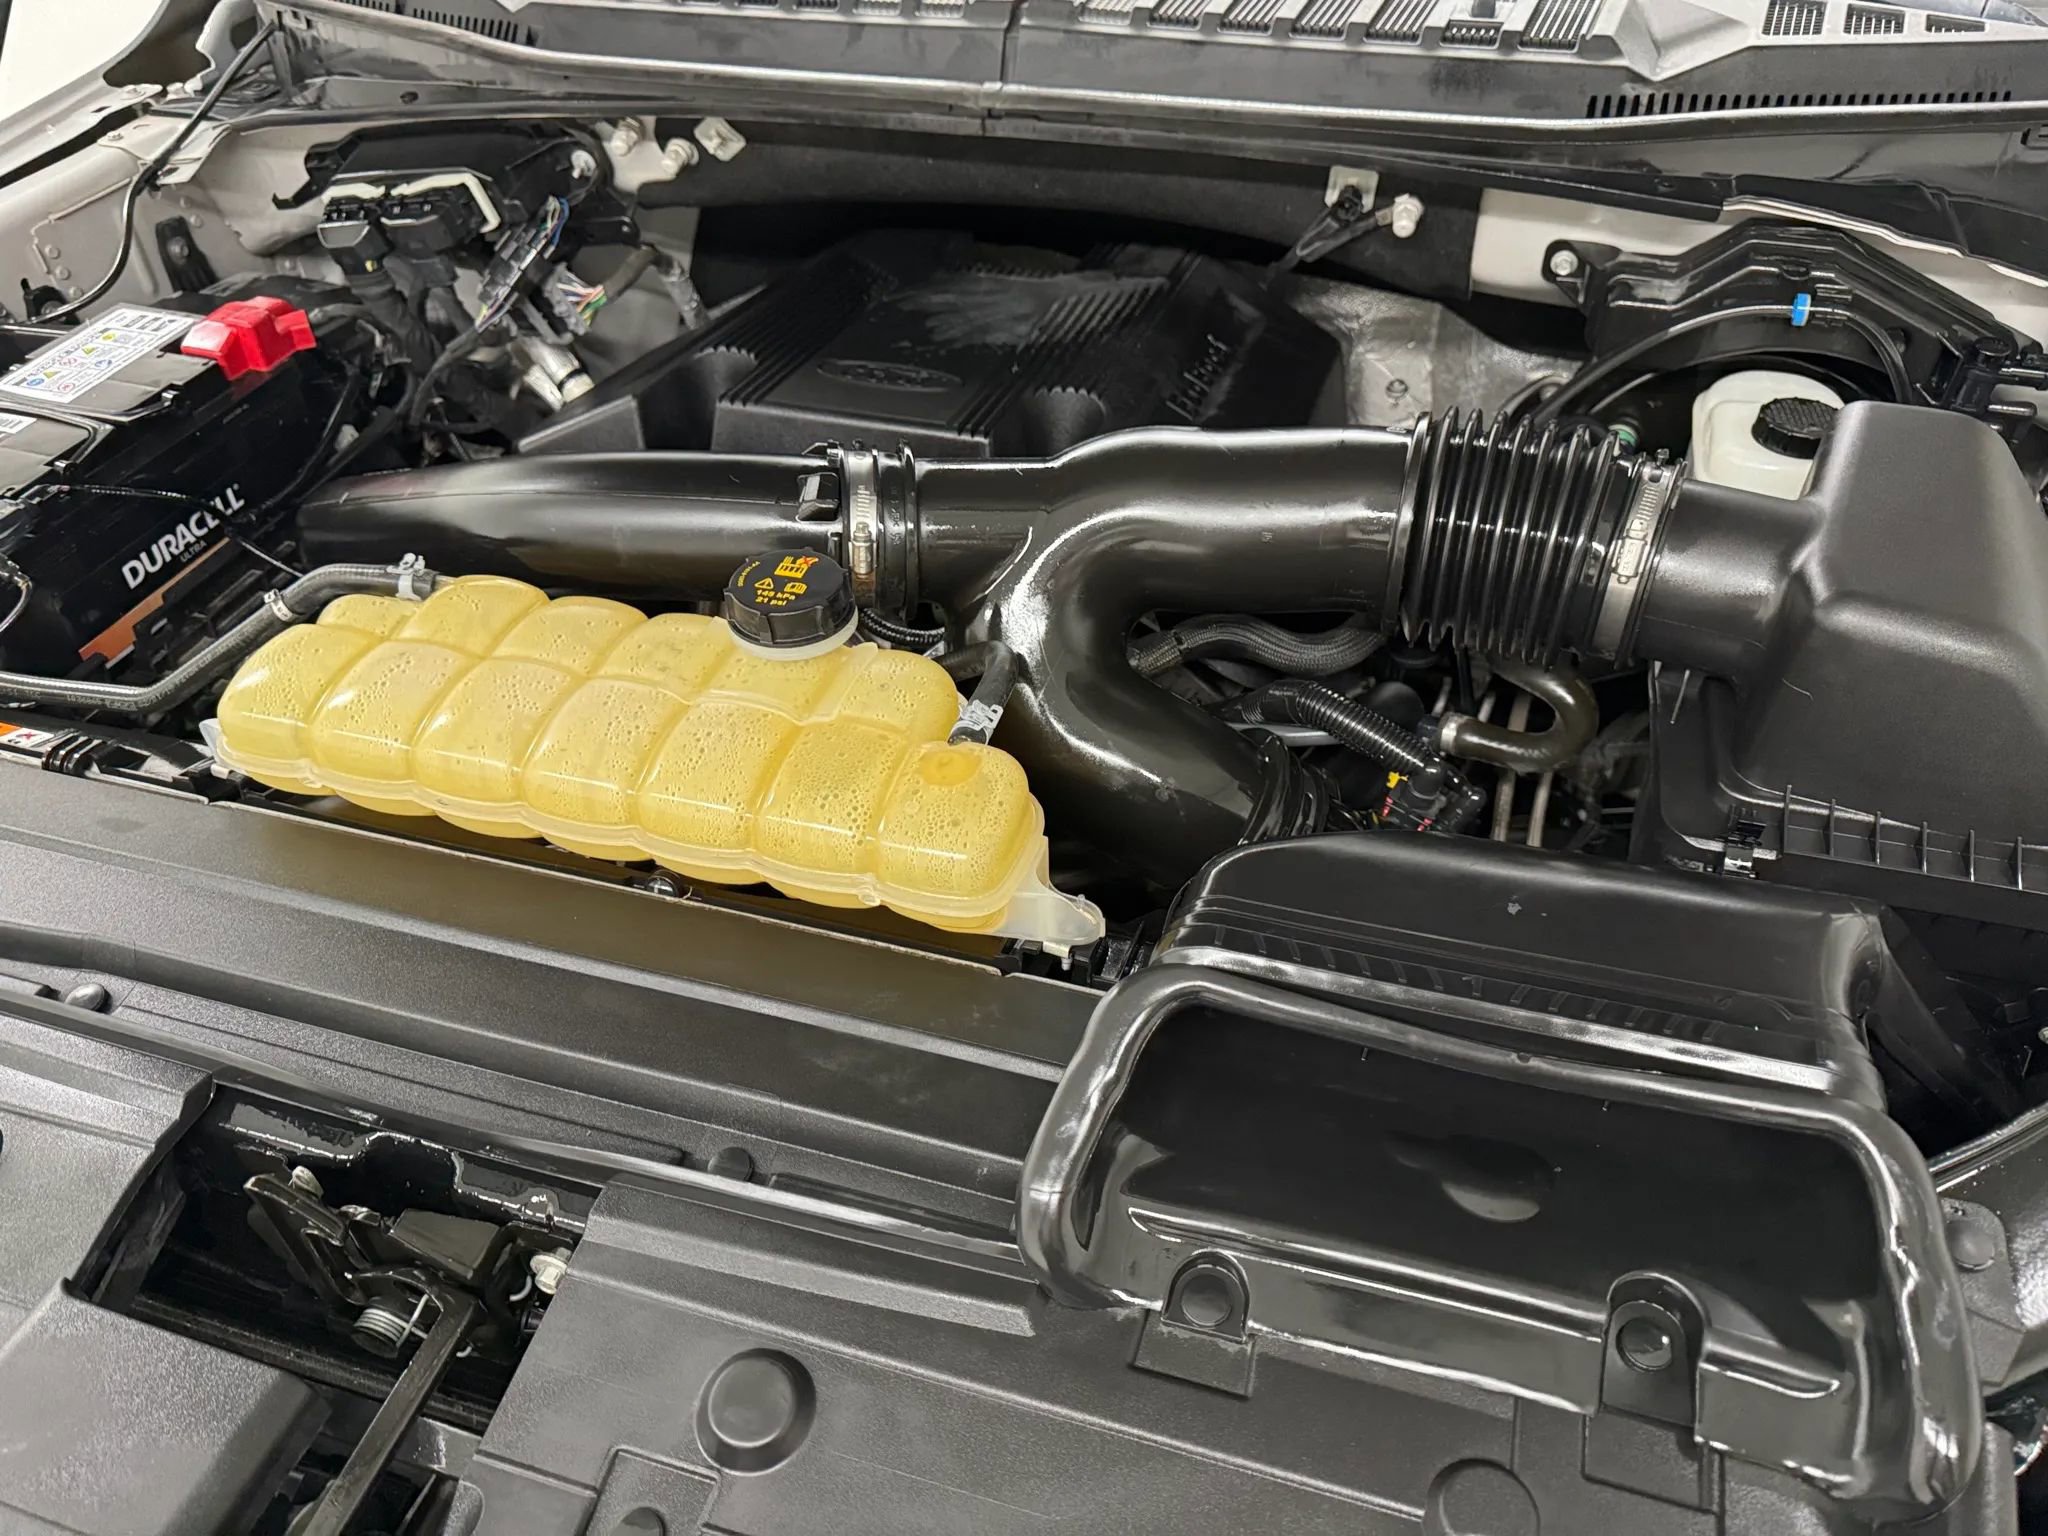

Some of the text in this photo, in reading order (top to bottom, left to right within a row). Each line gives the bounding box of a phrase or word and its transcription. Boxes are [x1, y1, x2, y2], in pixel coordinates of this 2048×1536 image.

[181, 541, 207, 562] ULTRA
[755, 596, 769, 604] 21
[776, 592, 796, 600] kPa
